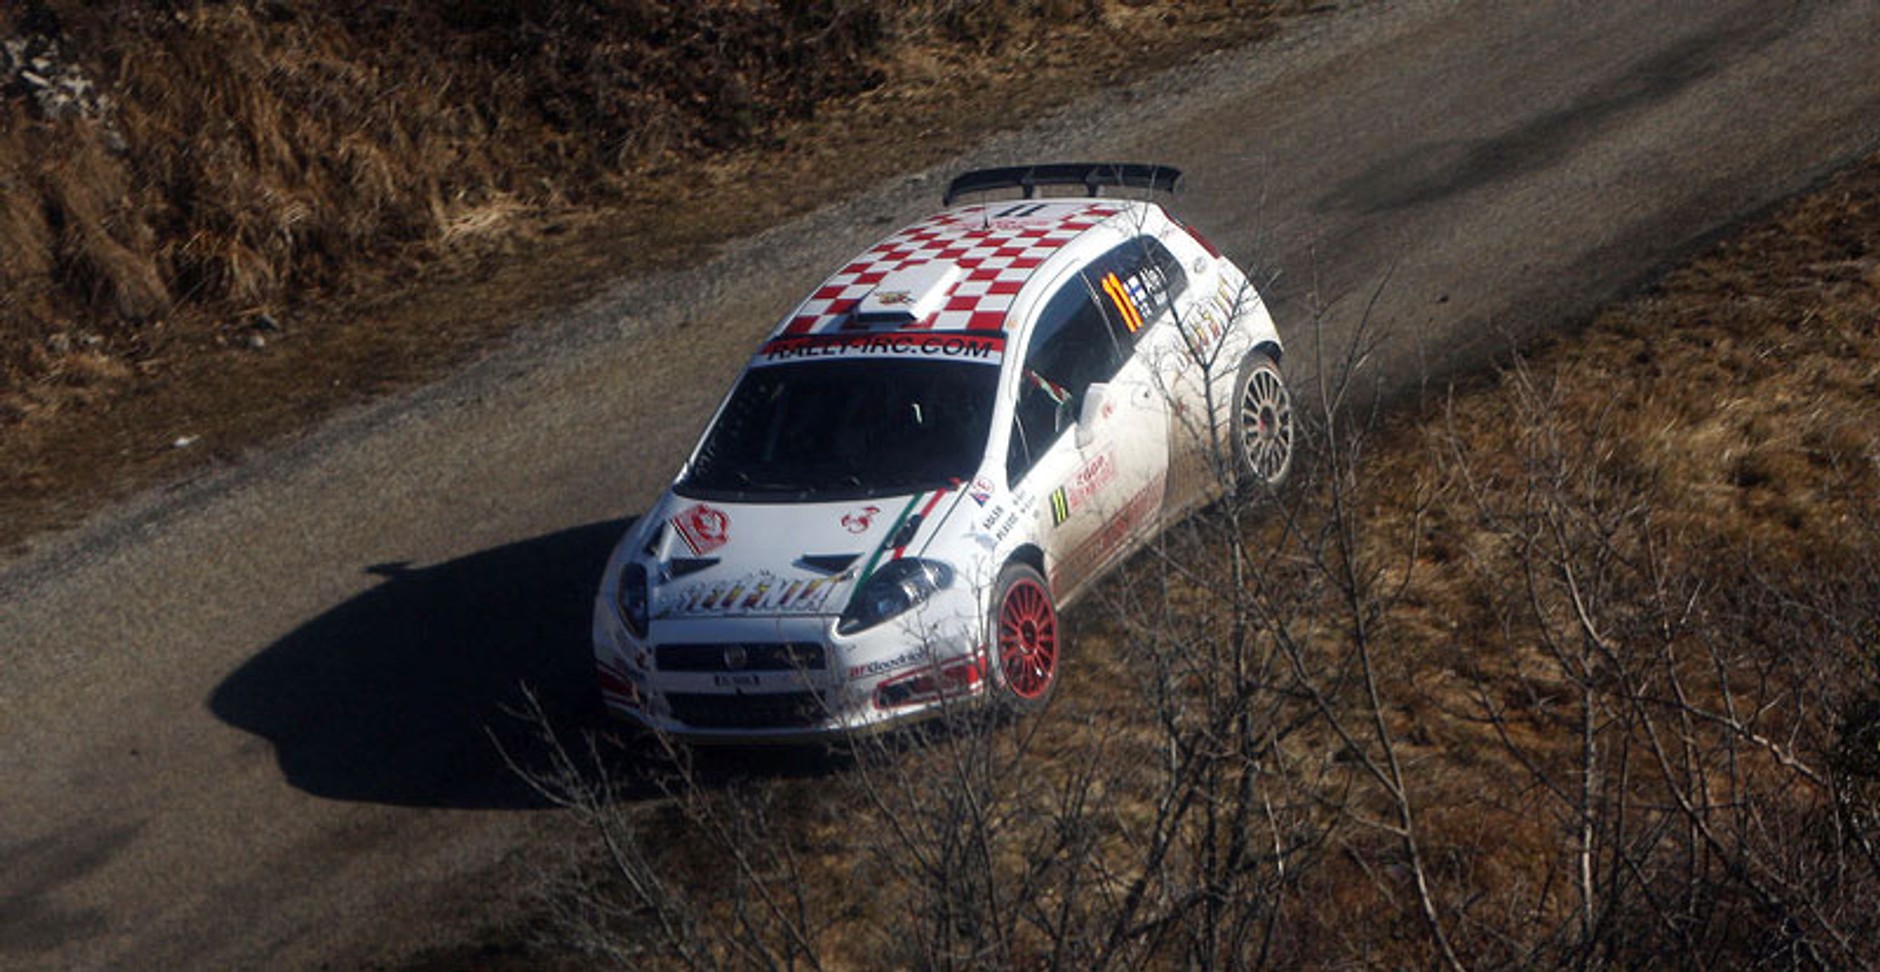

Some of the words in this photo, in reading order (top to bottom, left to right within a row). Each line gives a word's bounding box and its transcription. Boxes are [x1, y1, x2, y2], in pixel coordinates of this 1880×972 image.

[994, 204, 1048, 218] 11
[1102, 272, 1143, 333] 11
[767, 336, 992, 361] RALLY-IRC.COM
[1053, 488, 1067, 523] 11
